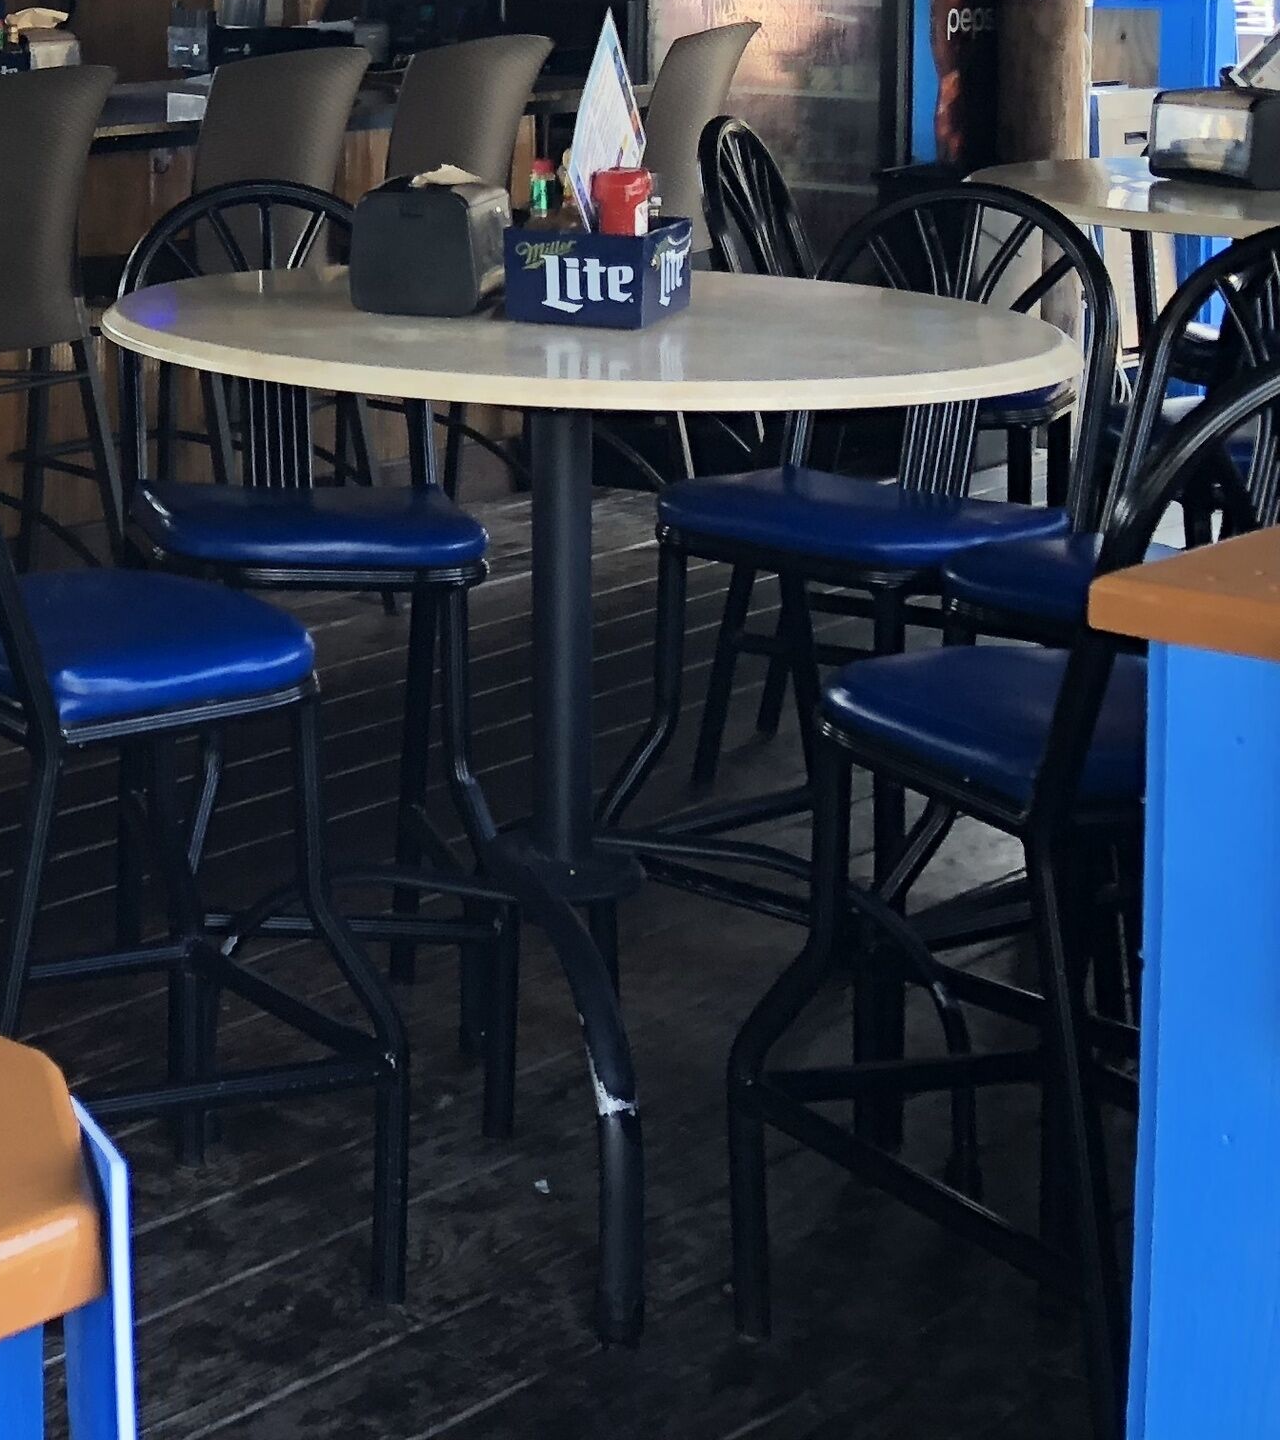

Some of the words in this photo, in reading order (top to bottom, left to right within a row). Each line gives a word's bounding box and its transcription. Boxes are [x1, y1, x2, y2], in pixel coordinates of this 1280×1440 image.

[947, 7, 996, 41] peps
[515, 240, 577, 269] Miller
[541, 254, 635, 313] Lite
[658, 248, 691, 308] Lite
